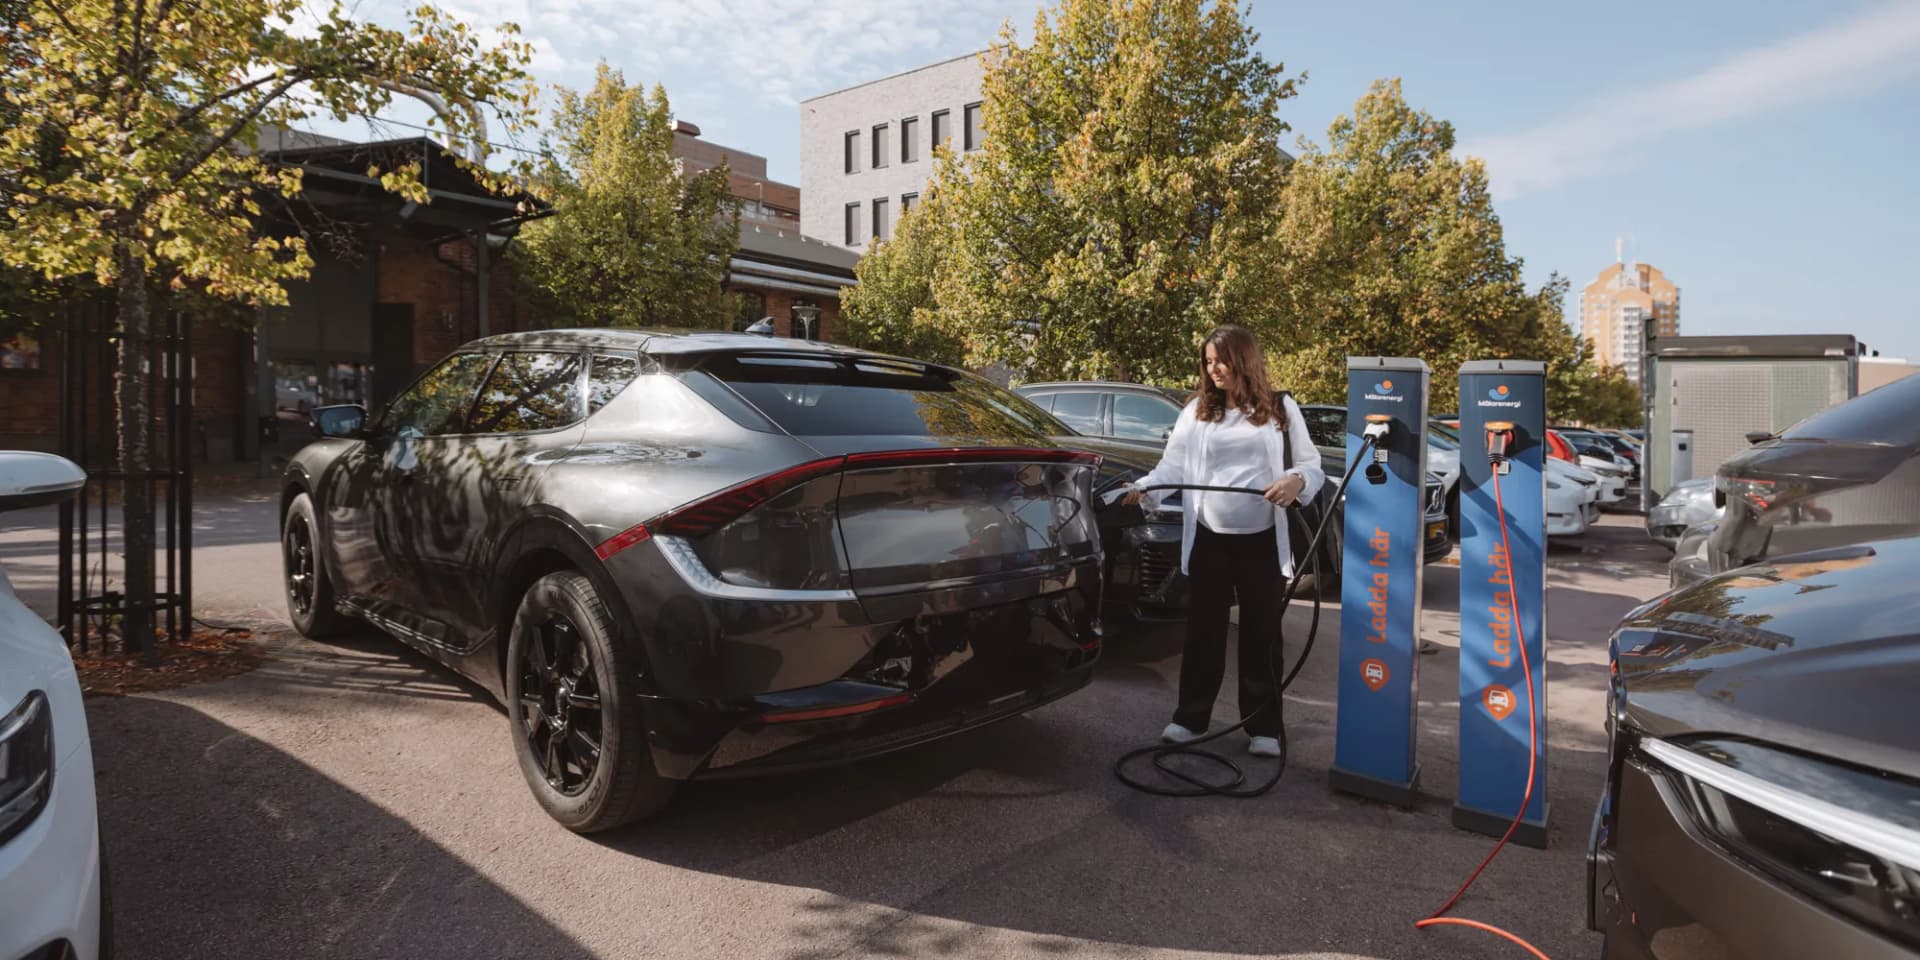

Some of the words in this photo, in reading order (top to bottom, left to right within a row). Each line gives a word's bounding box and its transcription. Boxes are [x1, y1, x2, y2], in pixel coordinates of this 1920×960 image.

[1369, 527, 1390, 567] här
[1488, 541, 1511, 584] här
[1366, 572, 1389, 643] Ladda
[1488, 592, 1511, 668] Ladda
